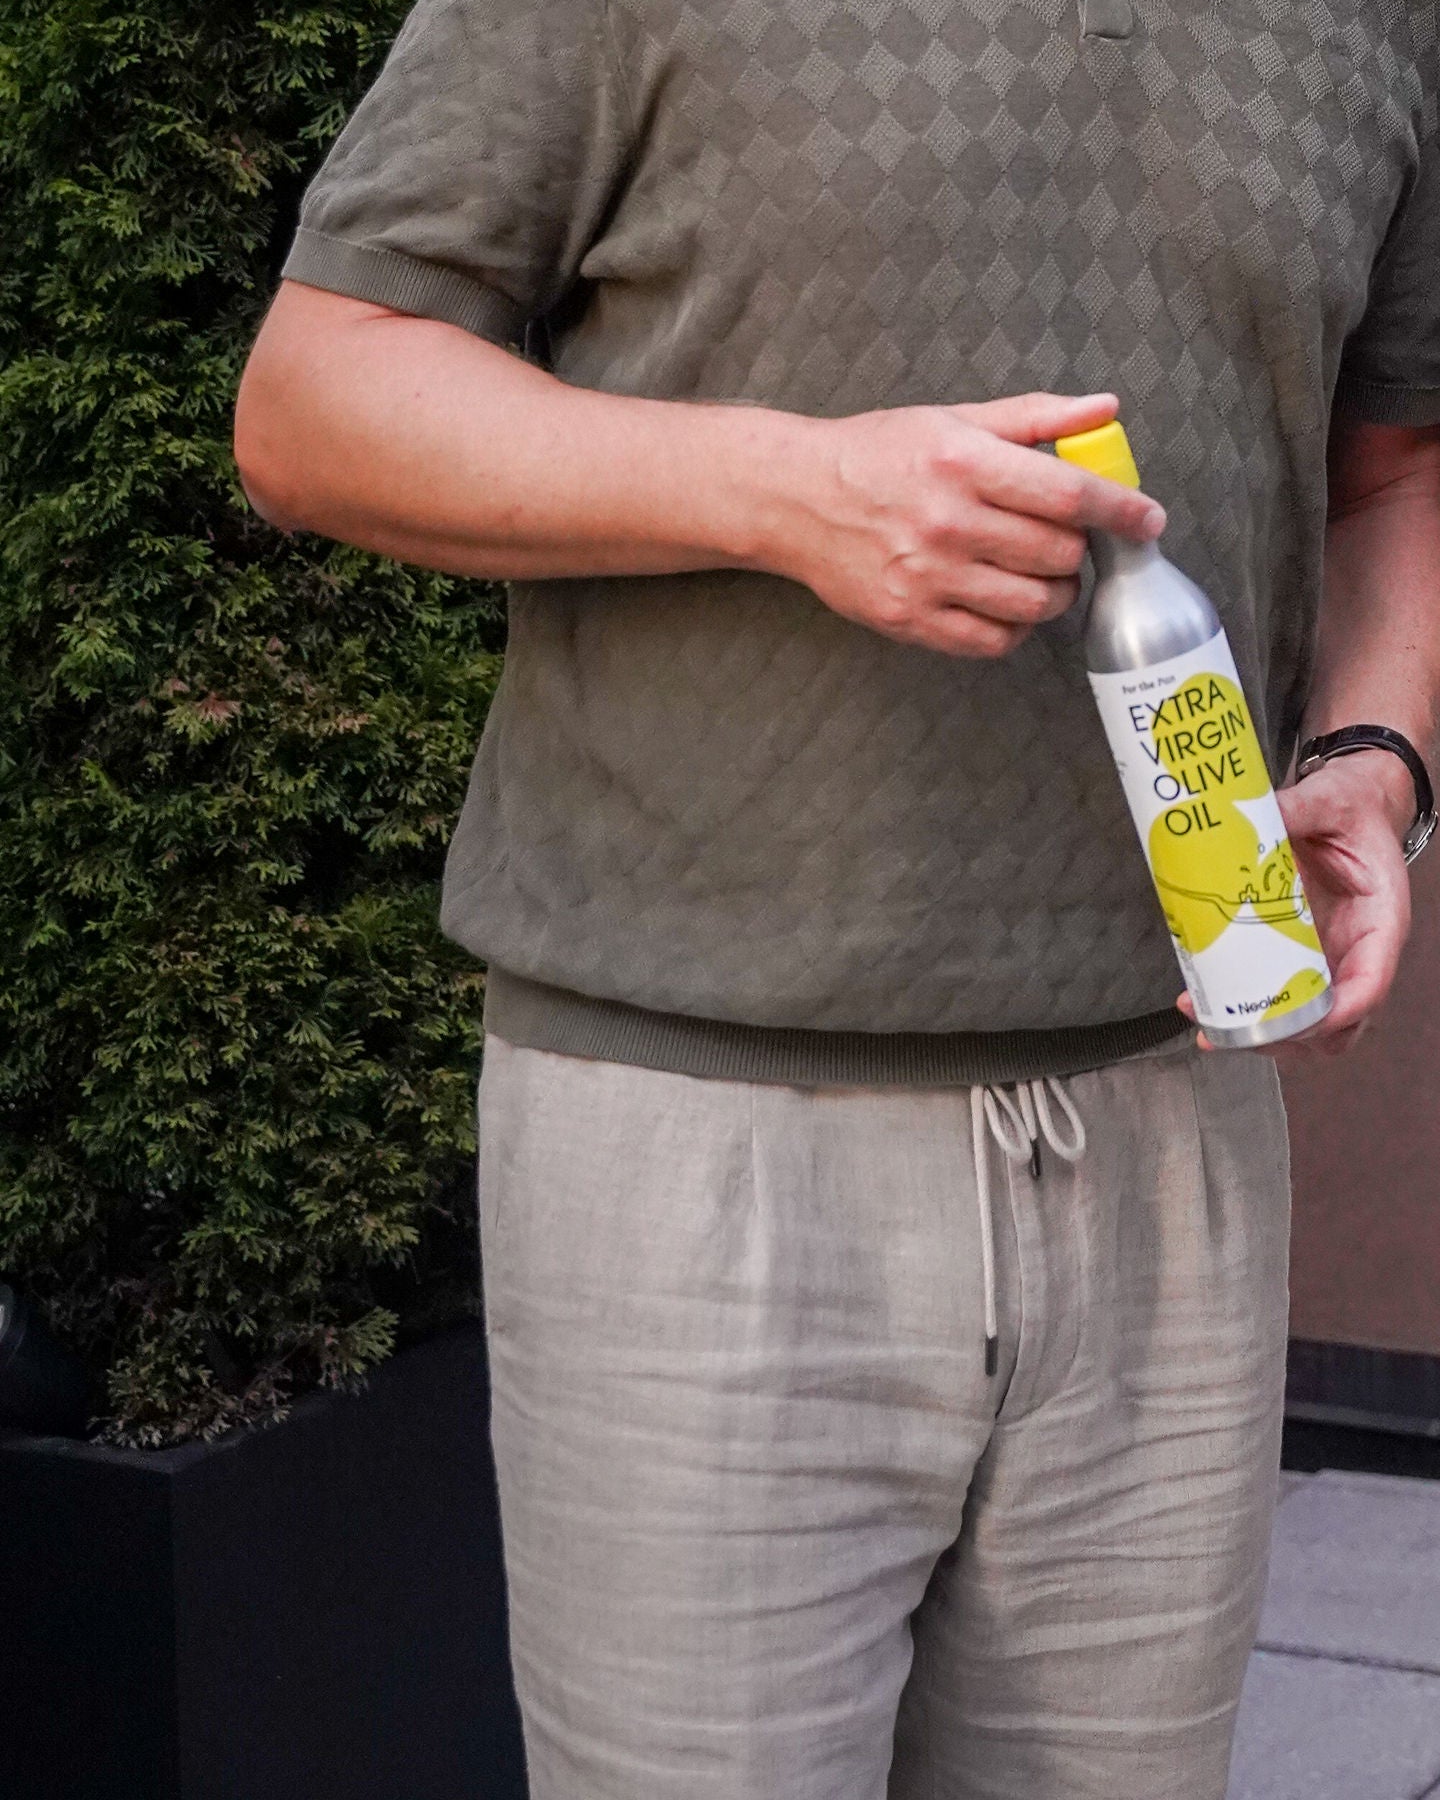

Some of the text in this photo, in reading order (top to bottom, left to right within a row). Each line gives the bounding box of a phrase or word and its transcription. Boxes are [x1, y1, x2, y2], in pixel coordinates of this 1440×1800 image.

[1128, 679, 1226, 733] EXTRA
[1140, 703, 1247, 766] VIRGIN
[1153, 747, 1246, 801] OLIVE
[1165, 802, 1222, 836] OIL
[1238, 990, 1291, 1015] Neolea
